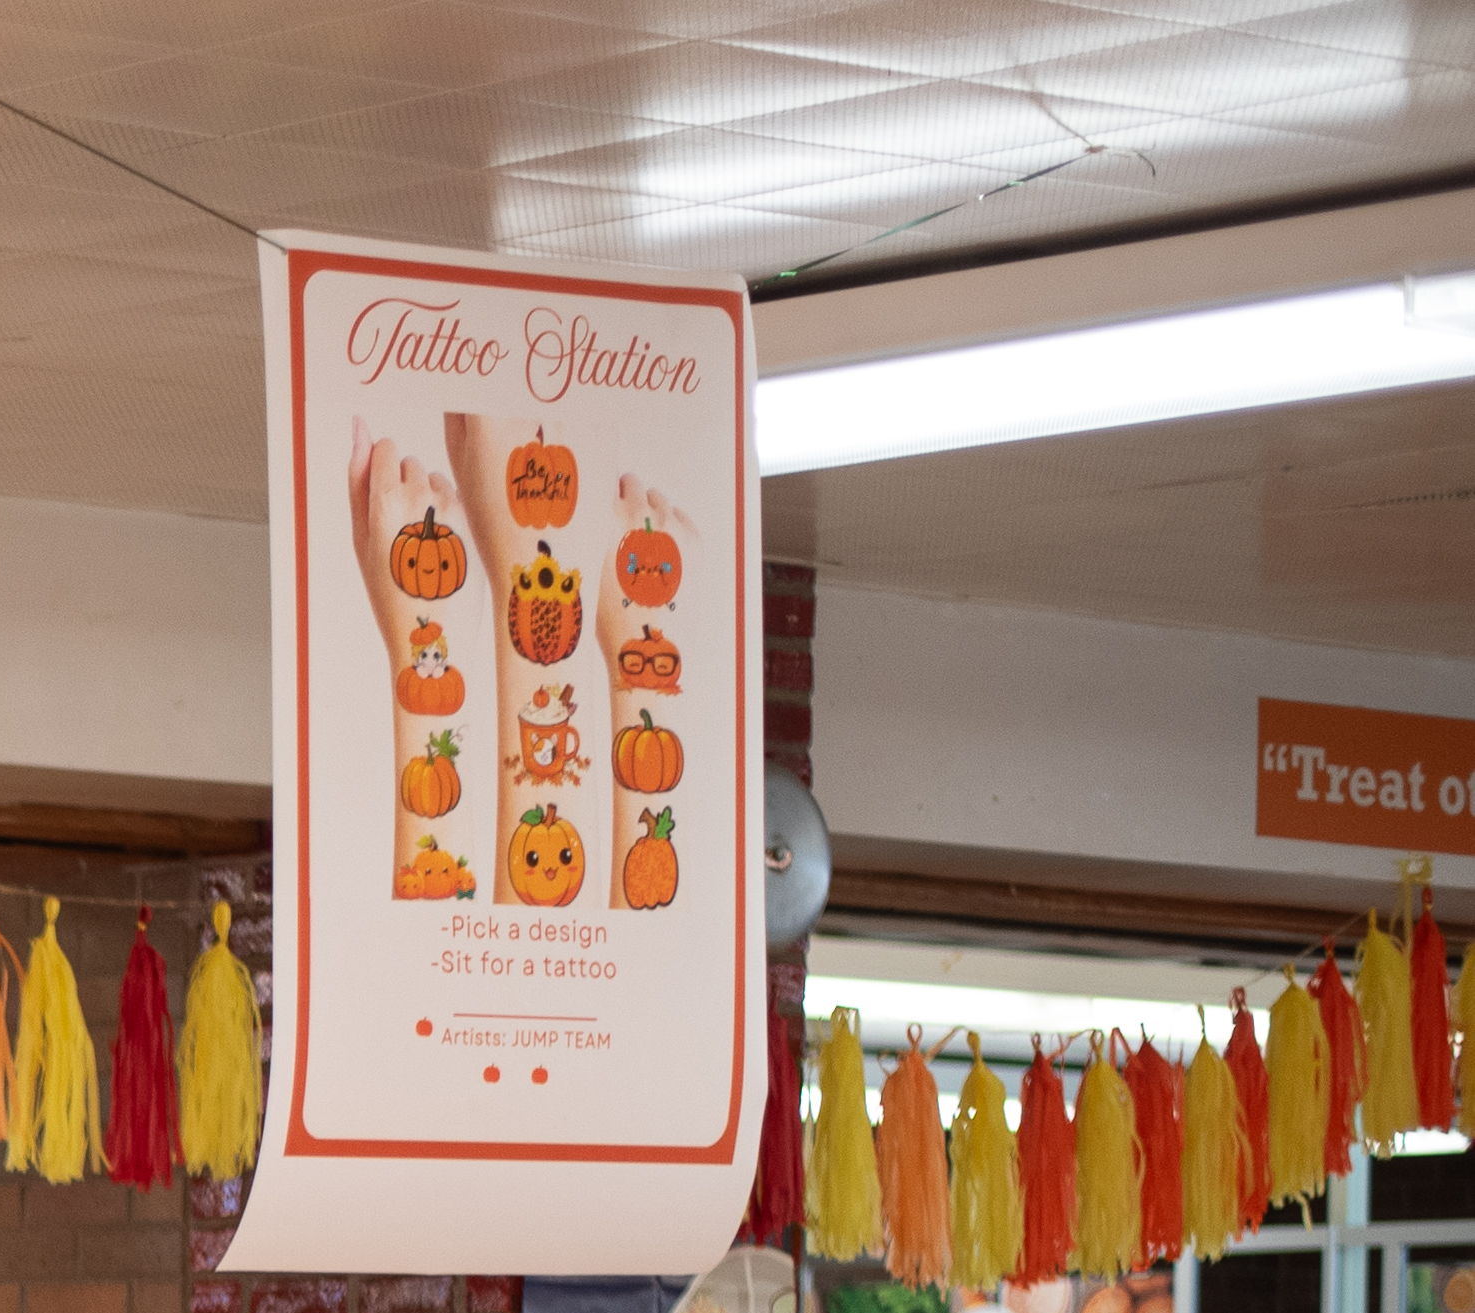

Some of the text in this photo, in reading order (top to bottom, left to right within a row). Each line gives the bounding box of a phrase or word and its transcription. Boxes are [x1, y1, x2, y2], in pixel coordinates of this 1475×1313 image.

[346, 297, 701, 403] Tattoo Station
[1262, 743, 1425, 813] “Treat
[441, 915, 607, 949] -Pick a design
[431, 950, 617, 980] -Sit for a tattoo
[441, 1027, 611, 1050] Artists: JUMP TEAM
